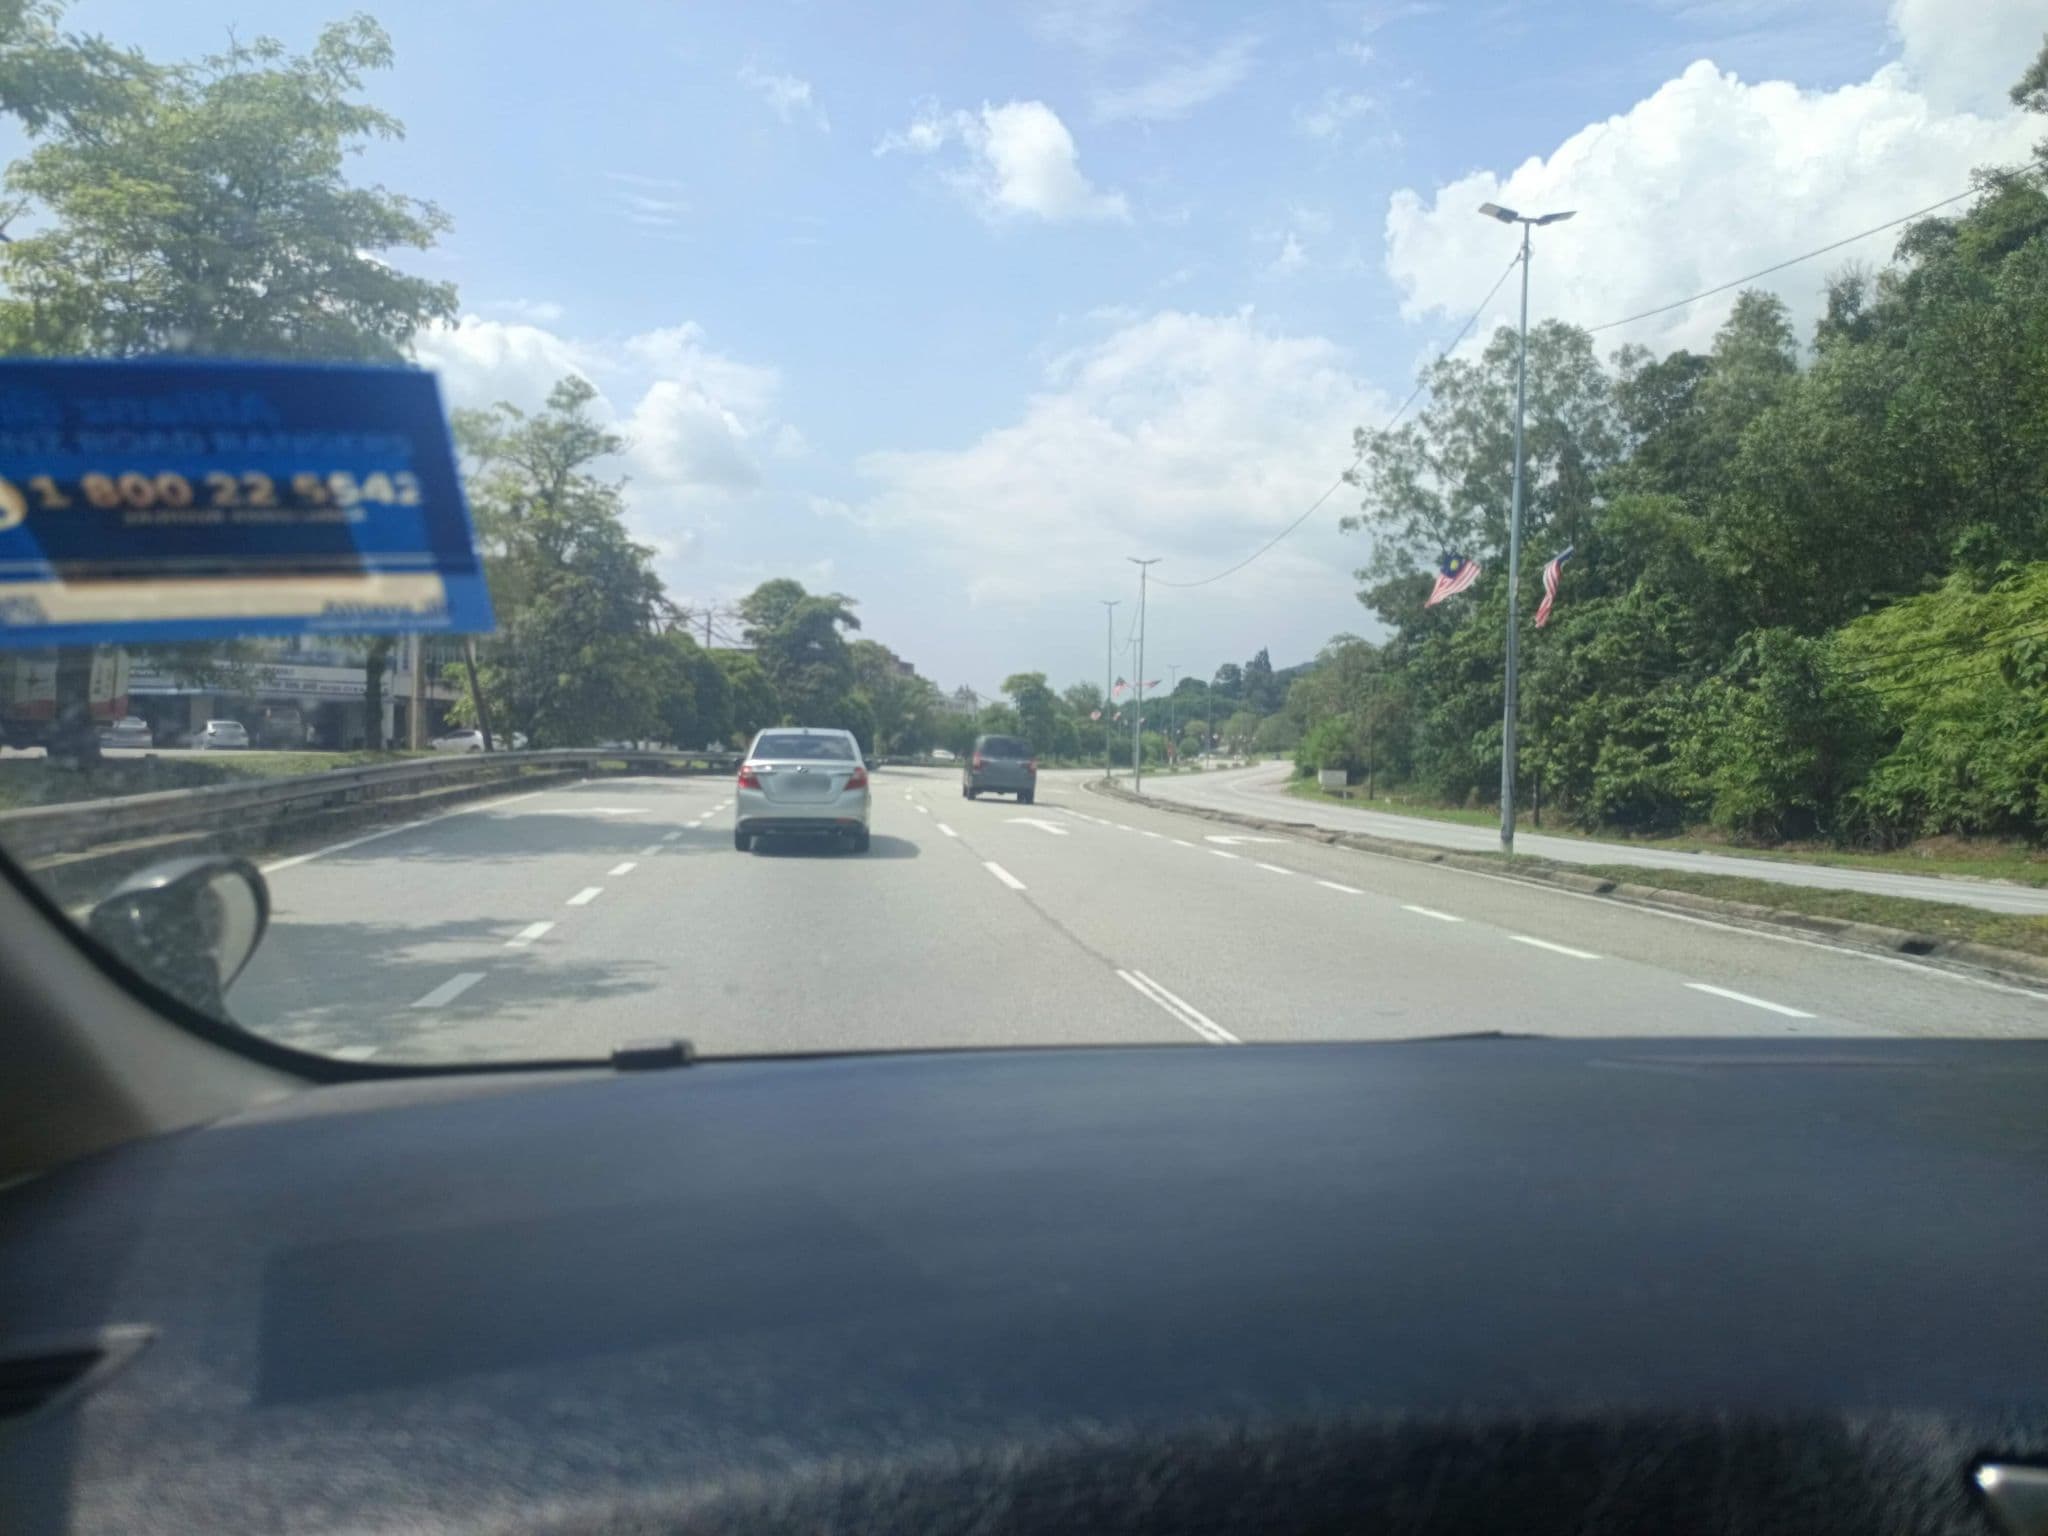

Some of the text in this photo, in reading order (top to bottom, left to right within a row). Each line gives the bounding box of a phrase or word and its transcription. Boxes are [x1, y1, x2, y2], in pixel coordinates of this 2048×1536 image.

[28, 474, 72, 507] 1
[81, 472, 194, 507] 800
[204, 472, 279, 506] 22
